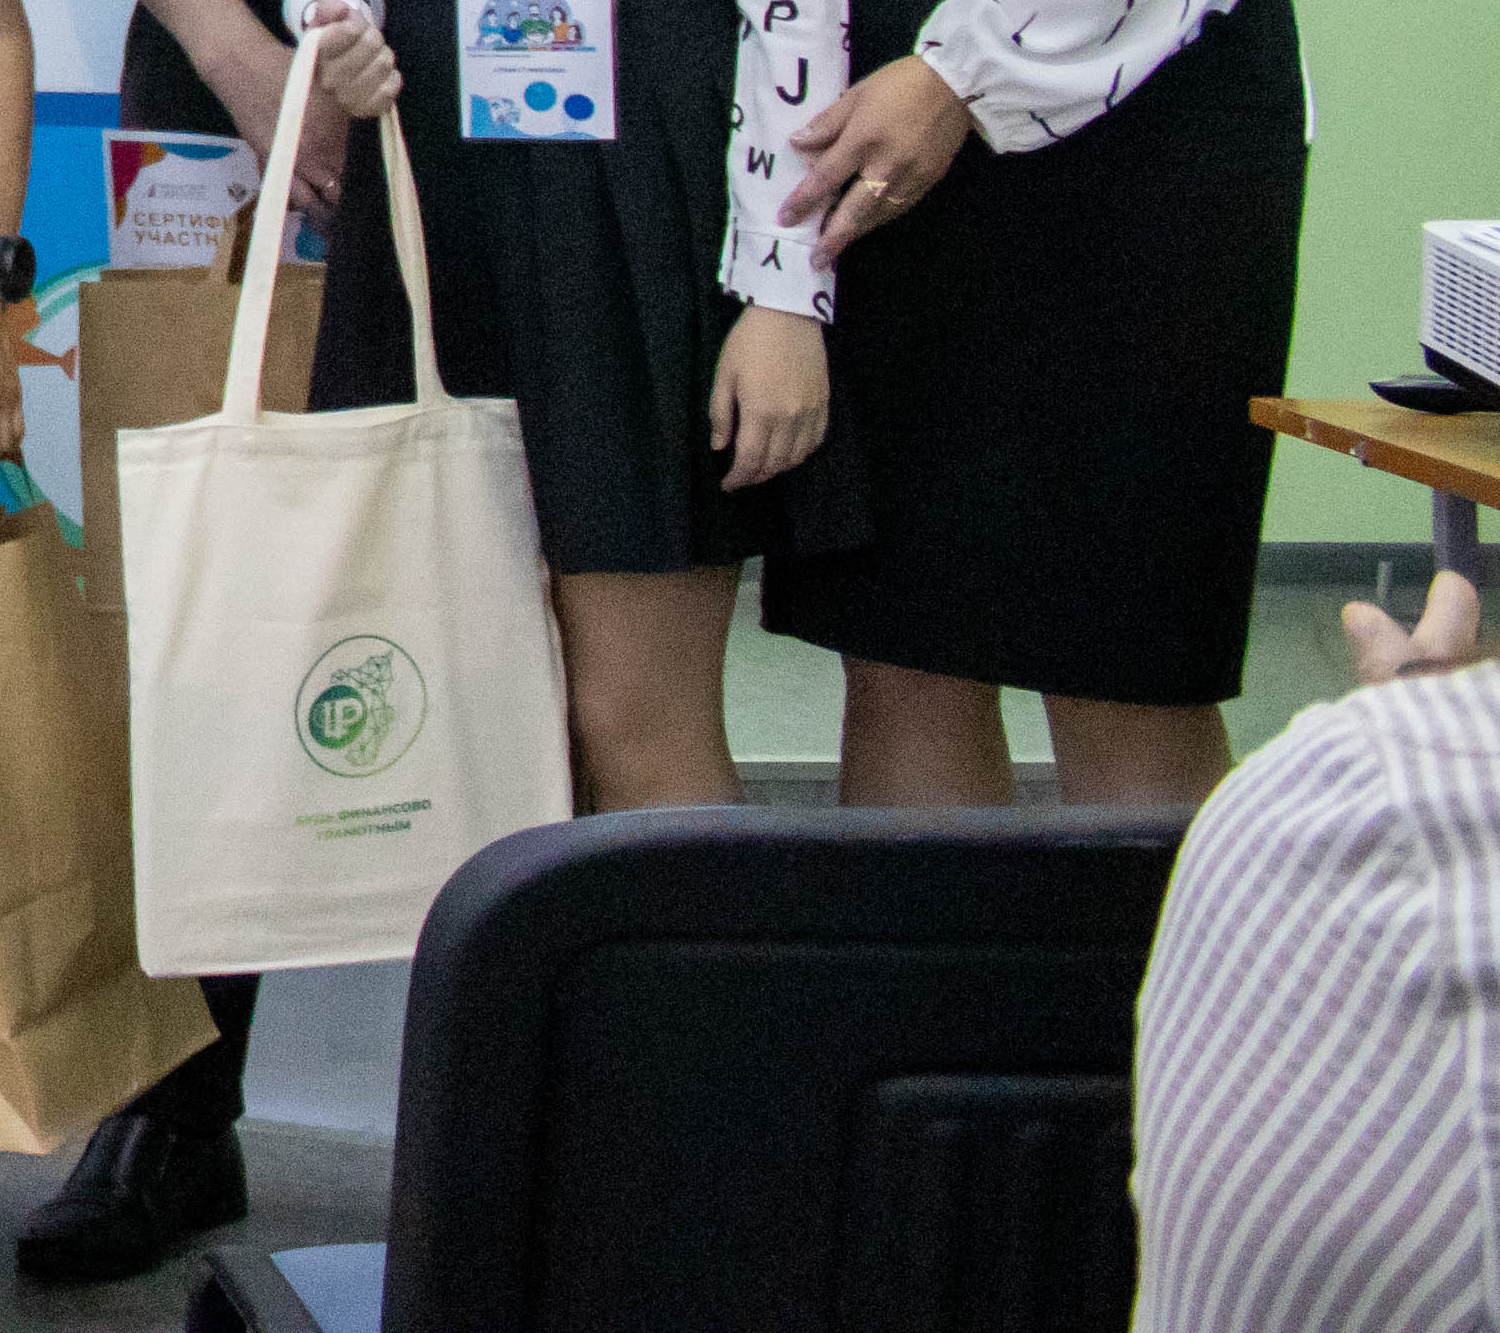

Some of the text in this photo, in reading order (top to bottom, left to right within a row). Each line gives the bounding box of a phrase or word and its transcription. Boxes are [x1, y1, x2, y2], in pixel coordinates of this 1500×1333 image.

[764, 0, 799, 33] P
[775, 56, 809, 107] J
[134, 229, 219, 247] УЧАСТН
[338, 799, 432, 821] ФИНАНСОВО
[316, 820, 412, 841] ГРАМОТНЫМ
